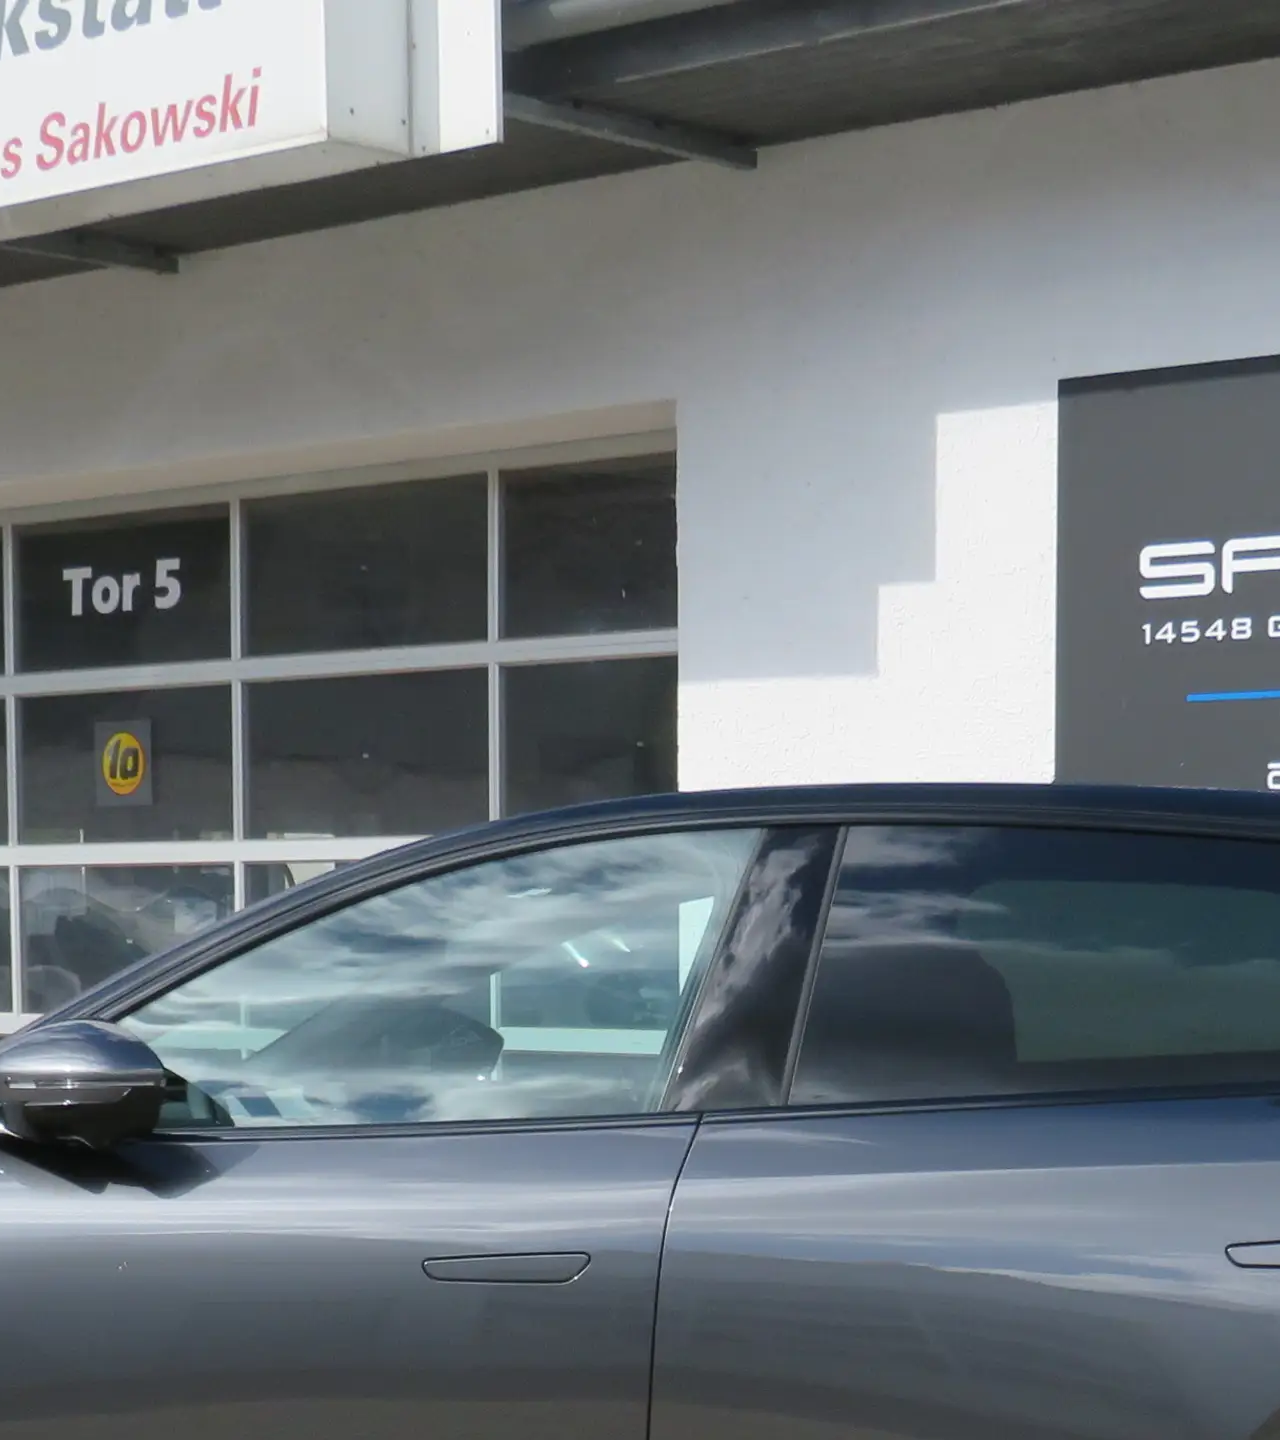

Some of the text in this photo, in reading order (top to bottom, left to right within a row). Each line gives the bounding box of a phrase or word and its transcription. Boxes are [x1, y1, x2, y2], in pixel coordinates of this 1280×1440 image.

[36, 66, 262, 172] Sakowski
[62, 557, 182, 617] Tor 5
[1141, 616, 1252, 645] 14548
